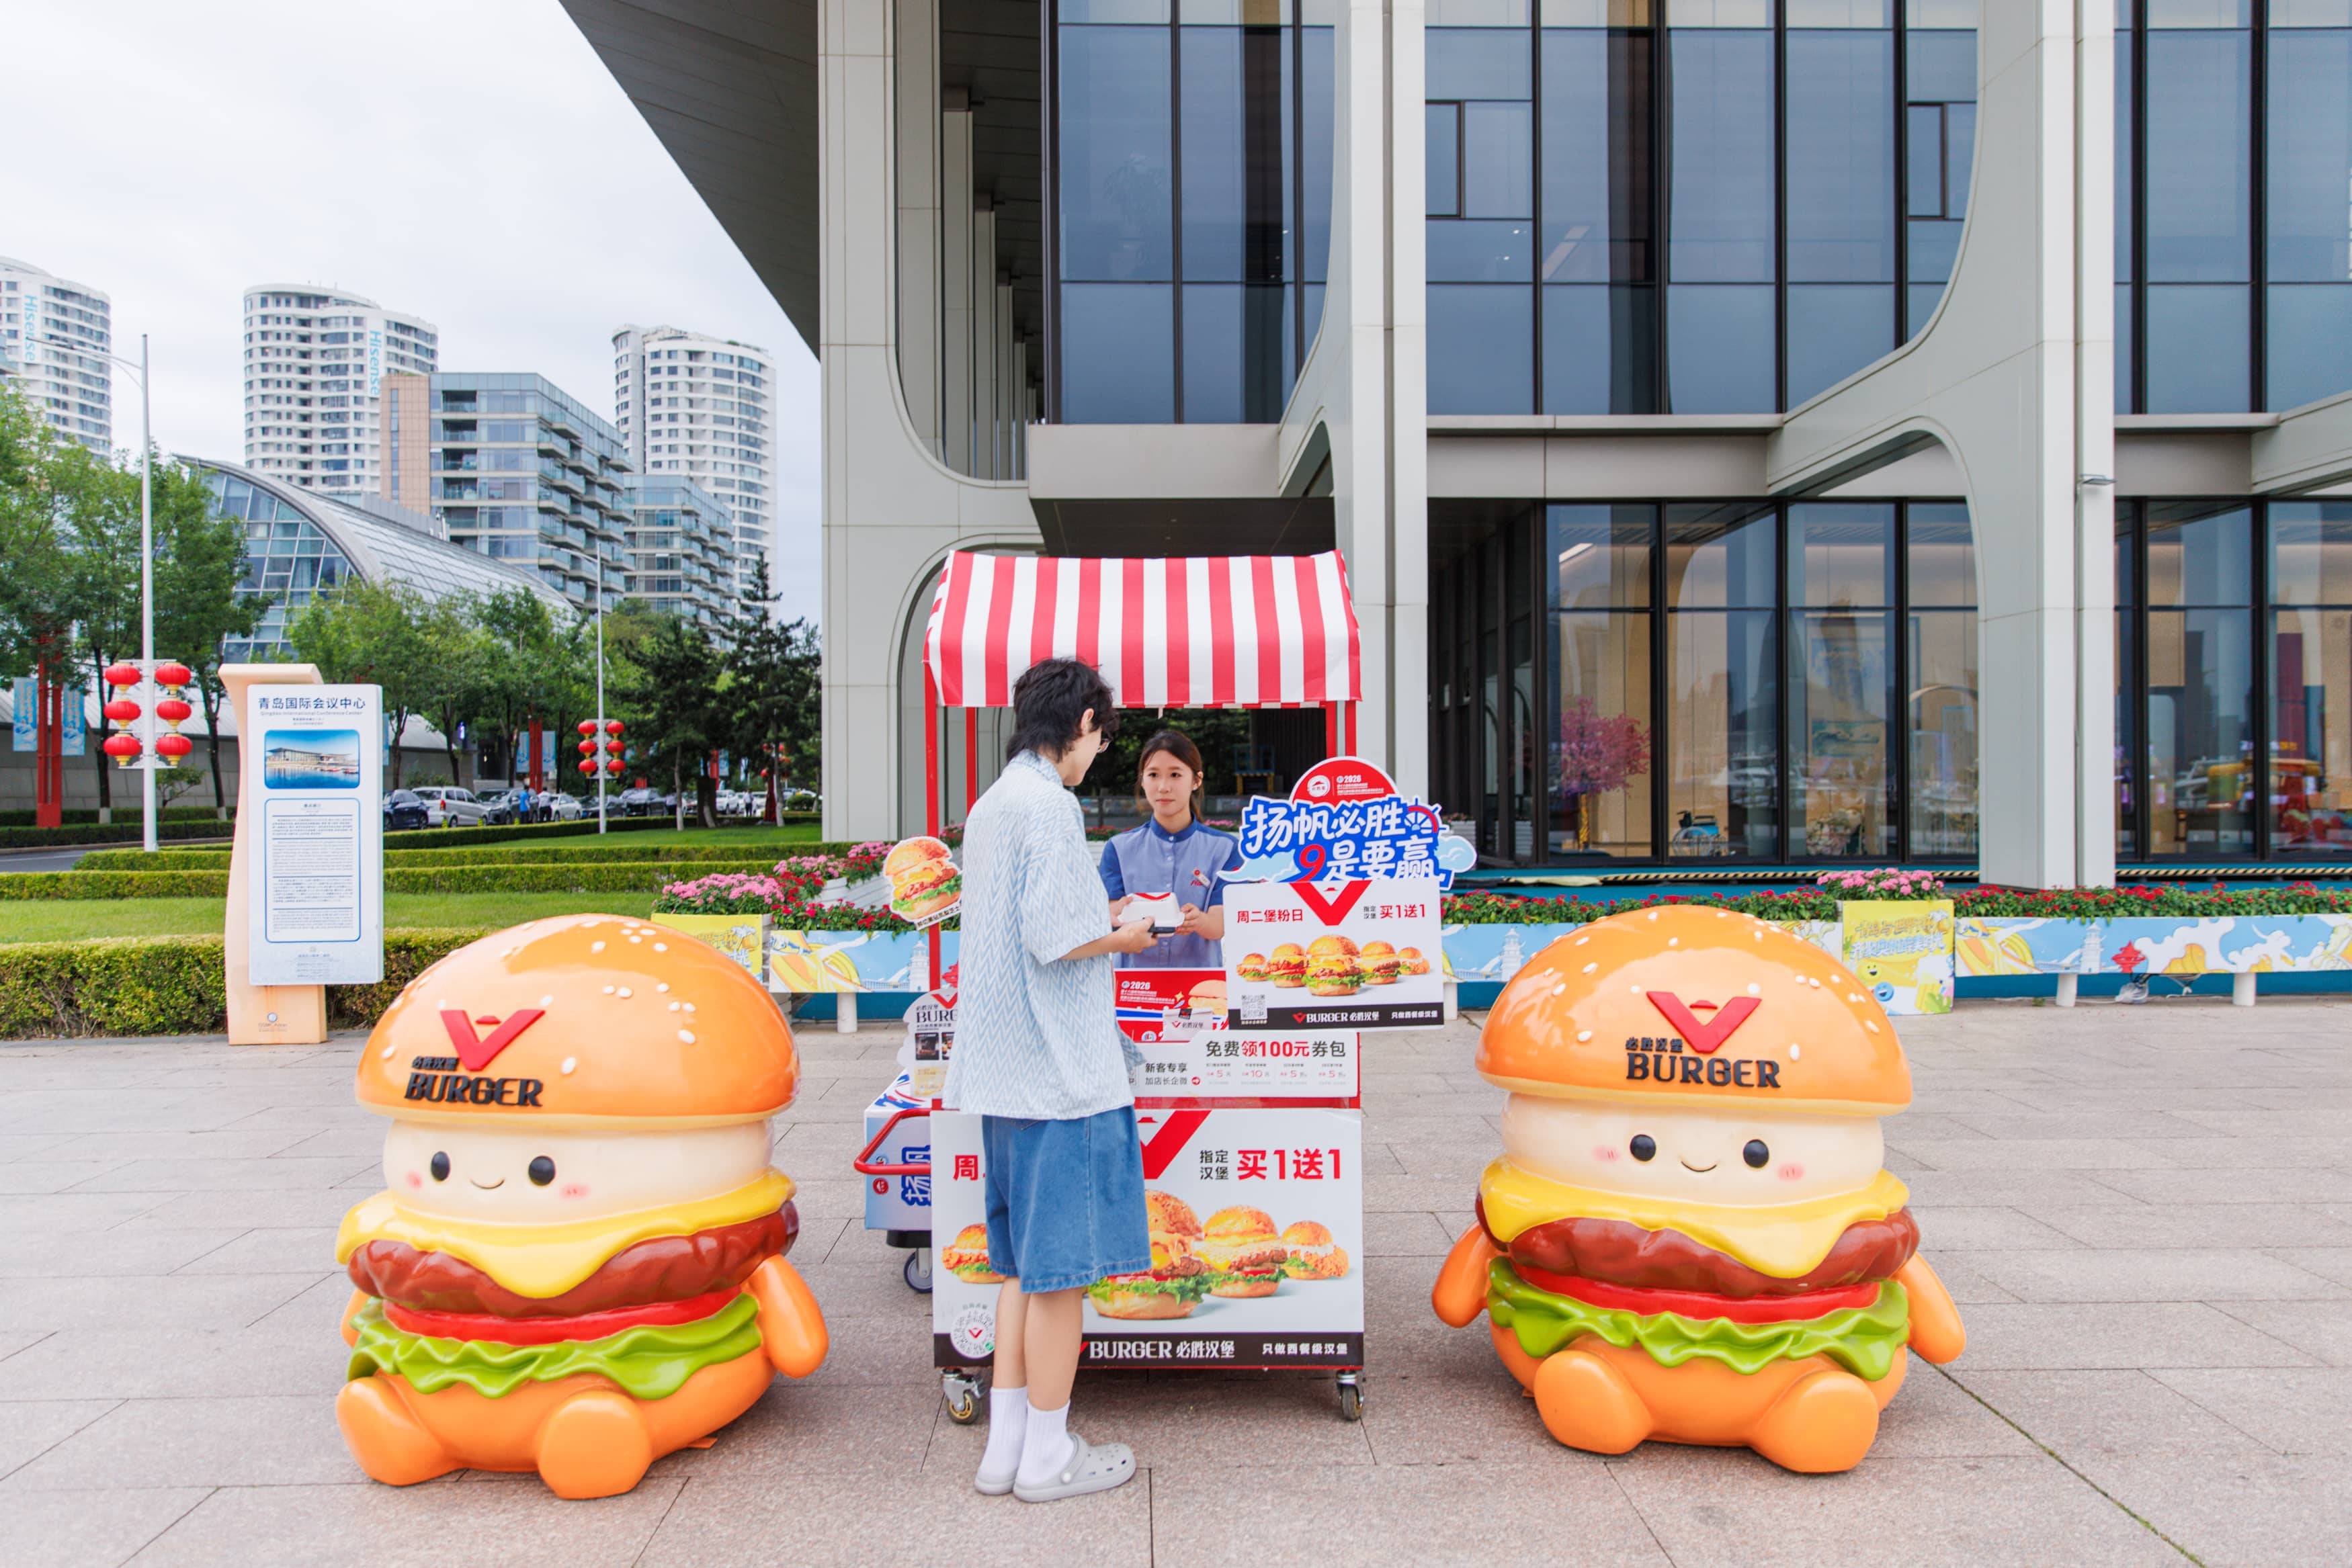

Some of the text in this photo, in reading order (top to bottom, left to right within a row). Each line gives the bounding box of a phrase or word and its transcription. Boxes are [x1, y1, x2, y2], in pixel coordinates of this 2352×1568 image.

[370, 330, 382, 396] Hisense
[258, 697, 366, 709] 青岛国际会议中心
[1245, 801, 1406, 855] 扬帆必胜
[1300, 836, 1442, 882] 9是要赢
[1236, 909, 1304, 924] 周二堡粉日
[1380, 904, 1425, 919] 买1送1
[1306, 1011, 1380, 1023] BURGER 必胜汉堡
[1206, 1041, 1346, 1057] 免费领100元券包
[1145, 1063, 1187, 1073] 新客专享
[1626, 1052, 1781, 1088] BURGER
[404, 1072, 544, 1107] BURGER
[1200, 1149, 1229, 1164] 指定
[1237, 1149, 1341, 1181] 买1送1
[1200, 1166, 1229, 1180] 汉堡
[1089, 1340, 1235, 1359] BURGER 必胜汉堡
[1262, 1343, 1348, 1355] 只做西餐级汉堡
